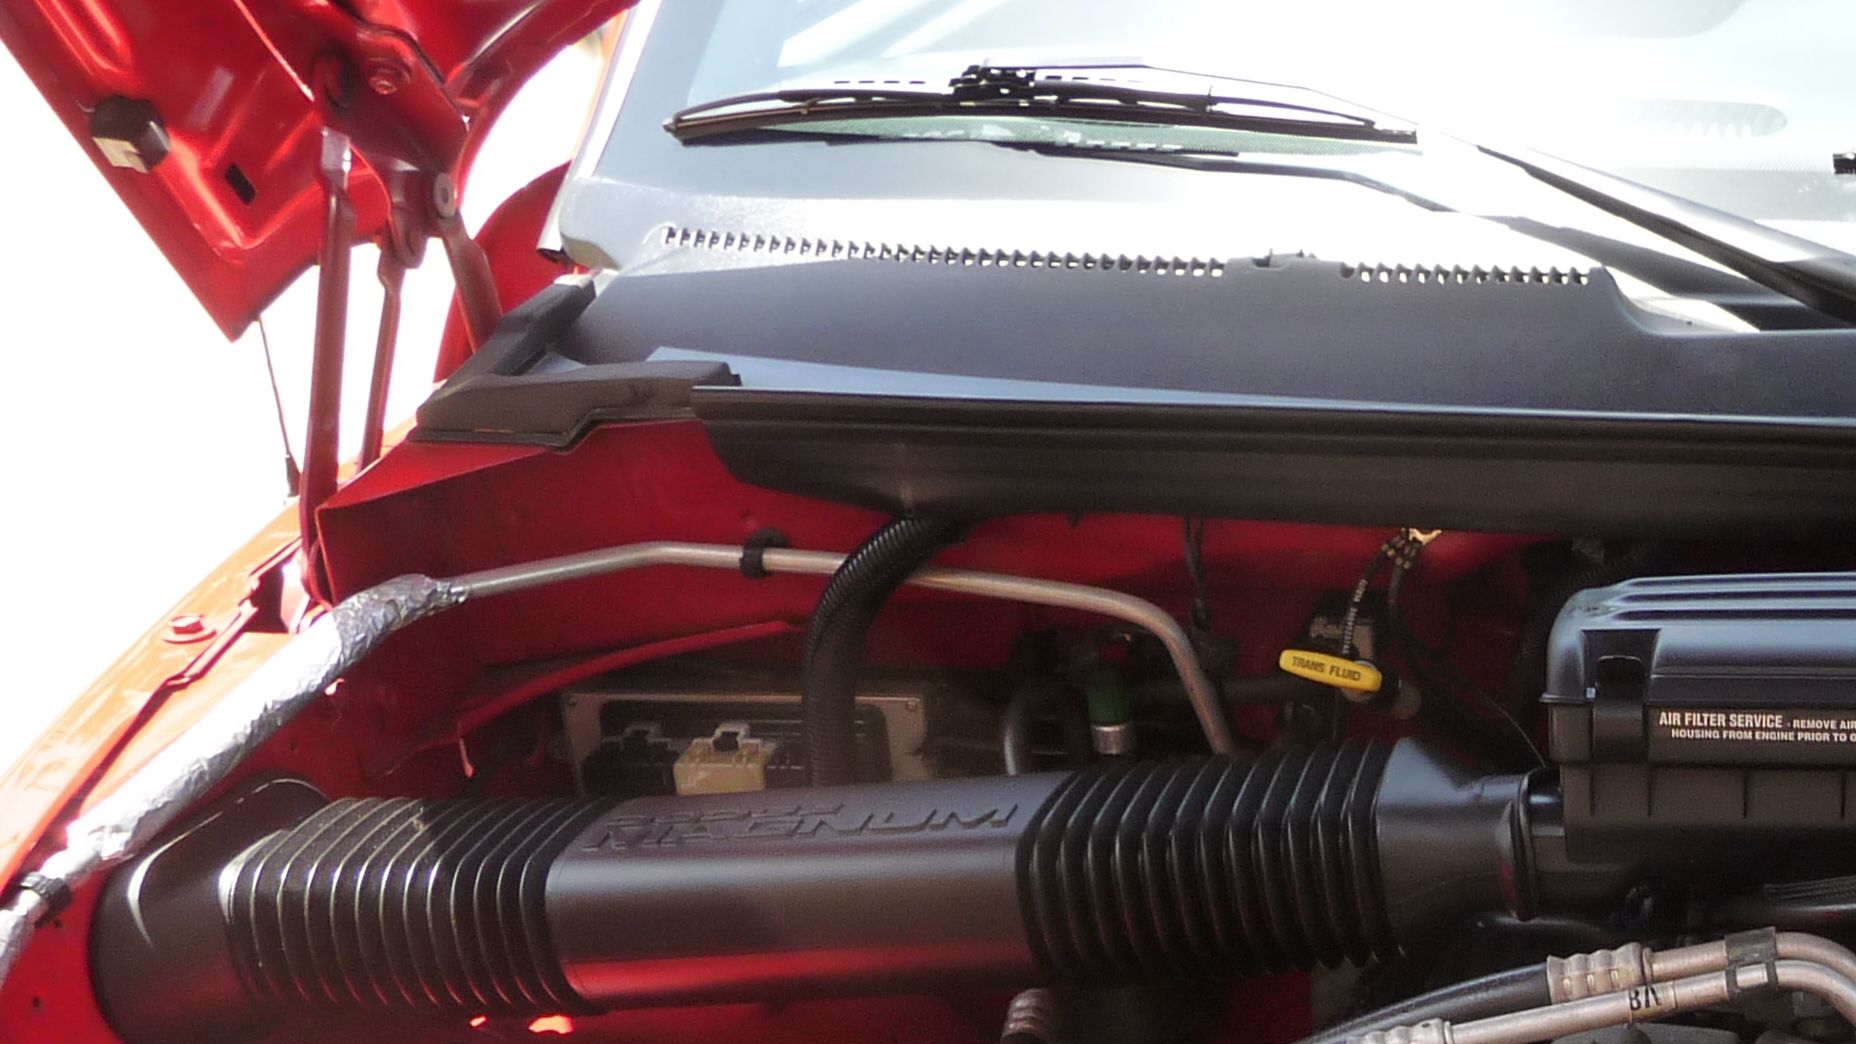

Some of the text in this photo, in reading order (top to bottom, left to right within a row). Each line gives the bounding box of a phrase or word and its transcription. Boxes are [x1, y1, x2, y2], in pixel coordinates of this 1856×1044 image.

[1292, 656, 1361, 681] TRANS FLUID
[1659, 712, 1681, 726] AIR
[1684, 712, 1726, 727] FILTER
[1729, 714, 1783, 729] SERVICE
[1792, 719, 1838, 730] REMOVE
[1671, 729, 1721, 739] HOUSING
[1722, 730, 1753, 740] FROM
[1755, 730, 1795, 741] ENGINE
[1797, 731, 1830, 742] PRIOR
[1833, 732, 1848, 742] TO
